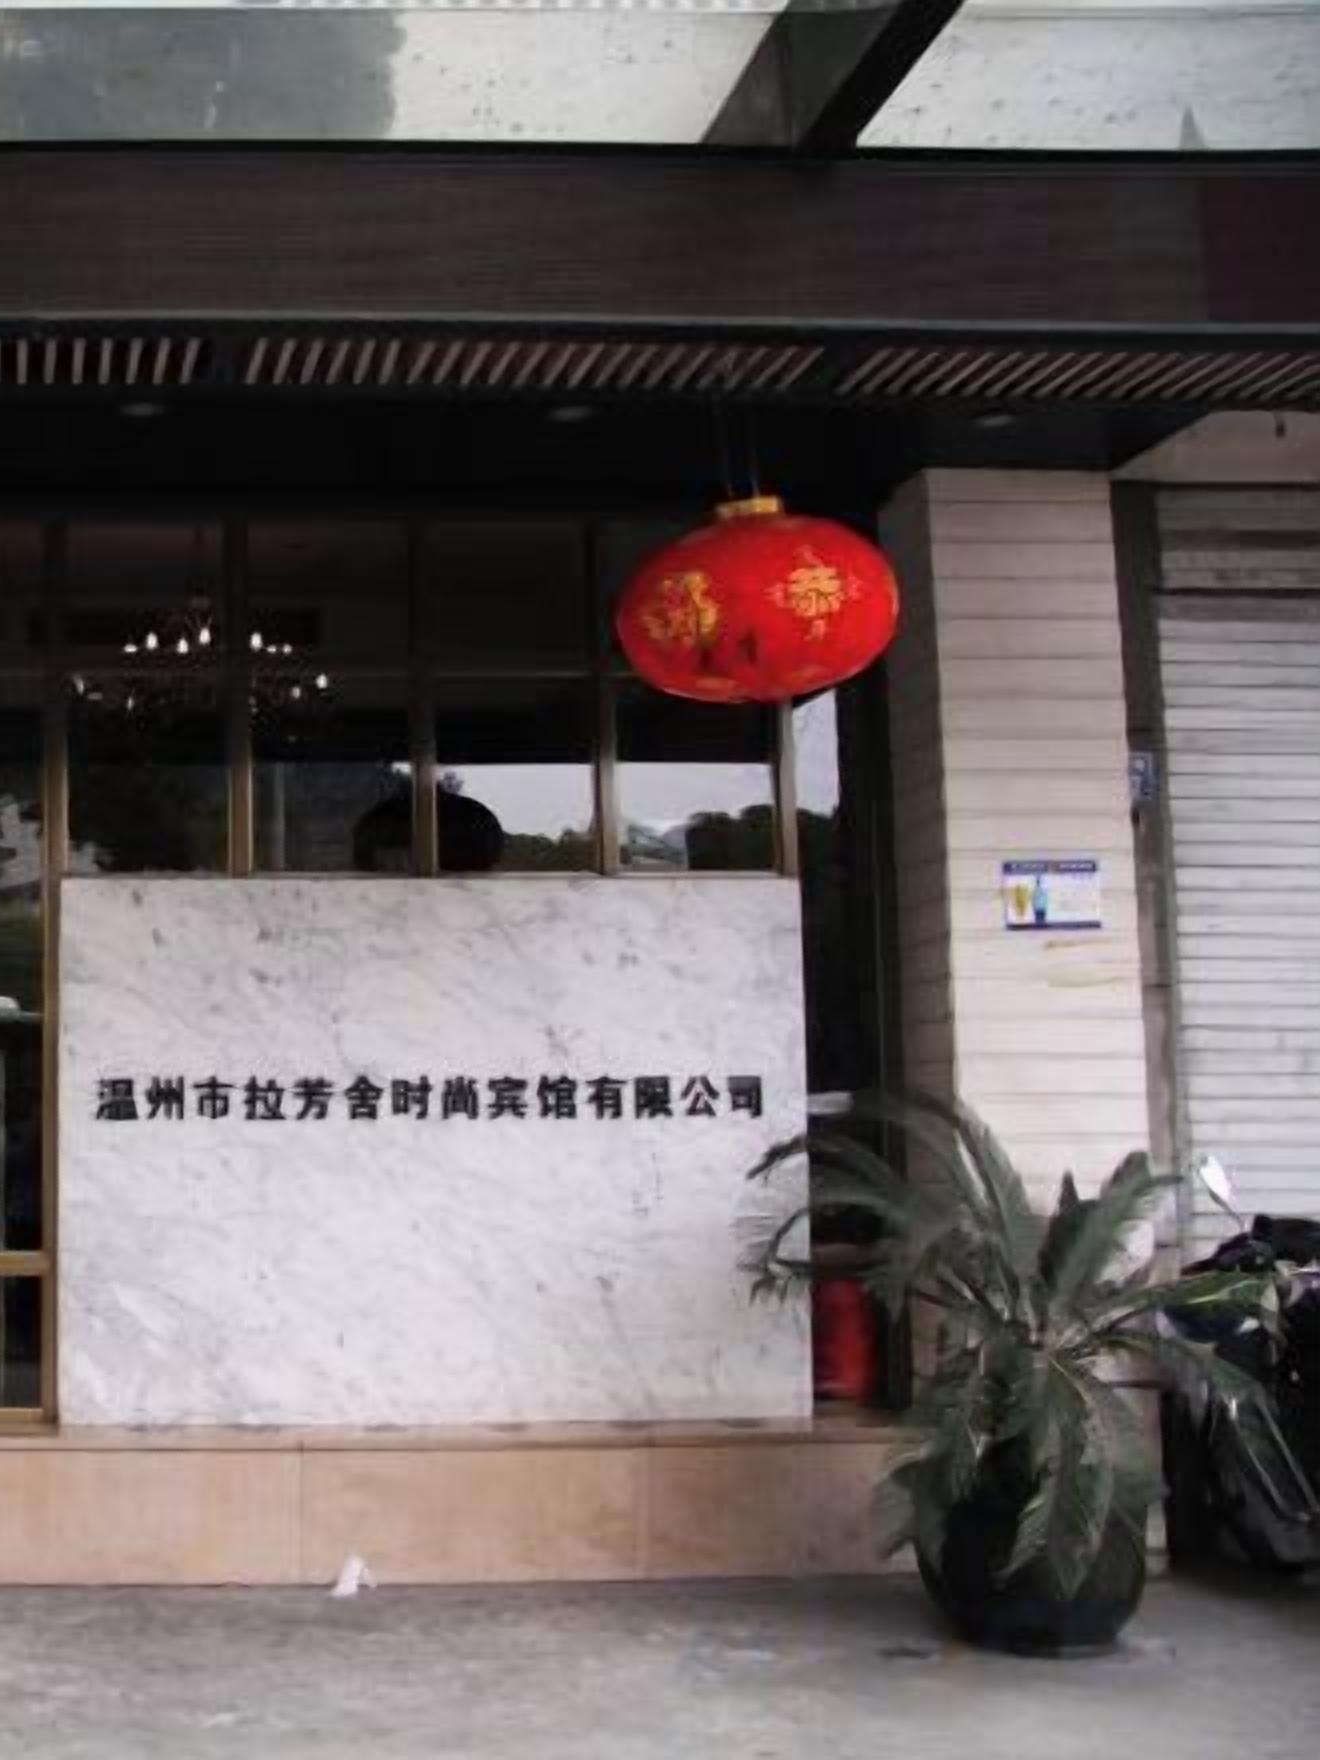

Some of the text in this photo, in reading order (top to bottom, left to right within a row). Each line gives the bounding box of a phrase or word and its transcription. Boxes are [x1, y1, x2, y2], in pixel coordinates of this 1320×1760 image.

[95, 1075, 764, 1121] 温州市拉芳舍时尚宾馆有限公司
